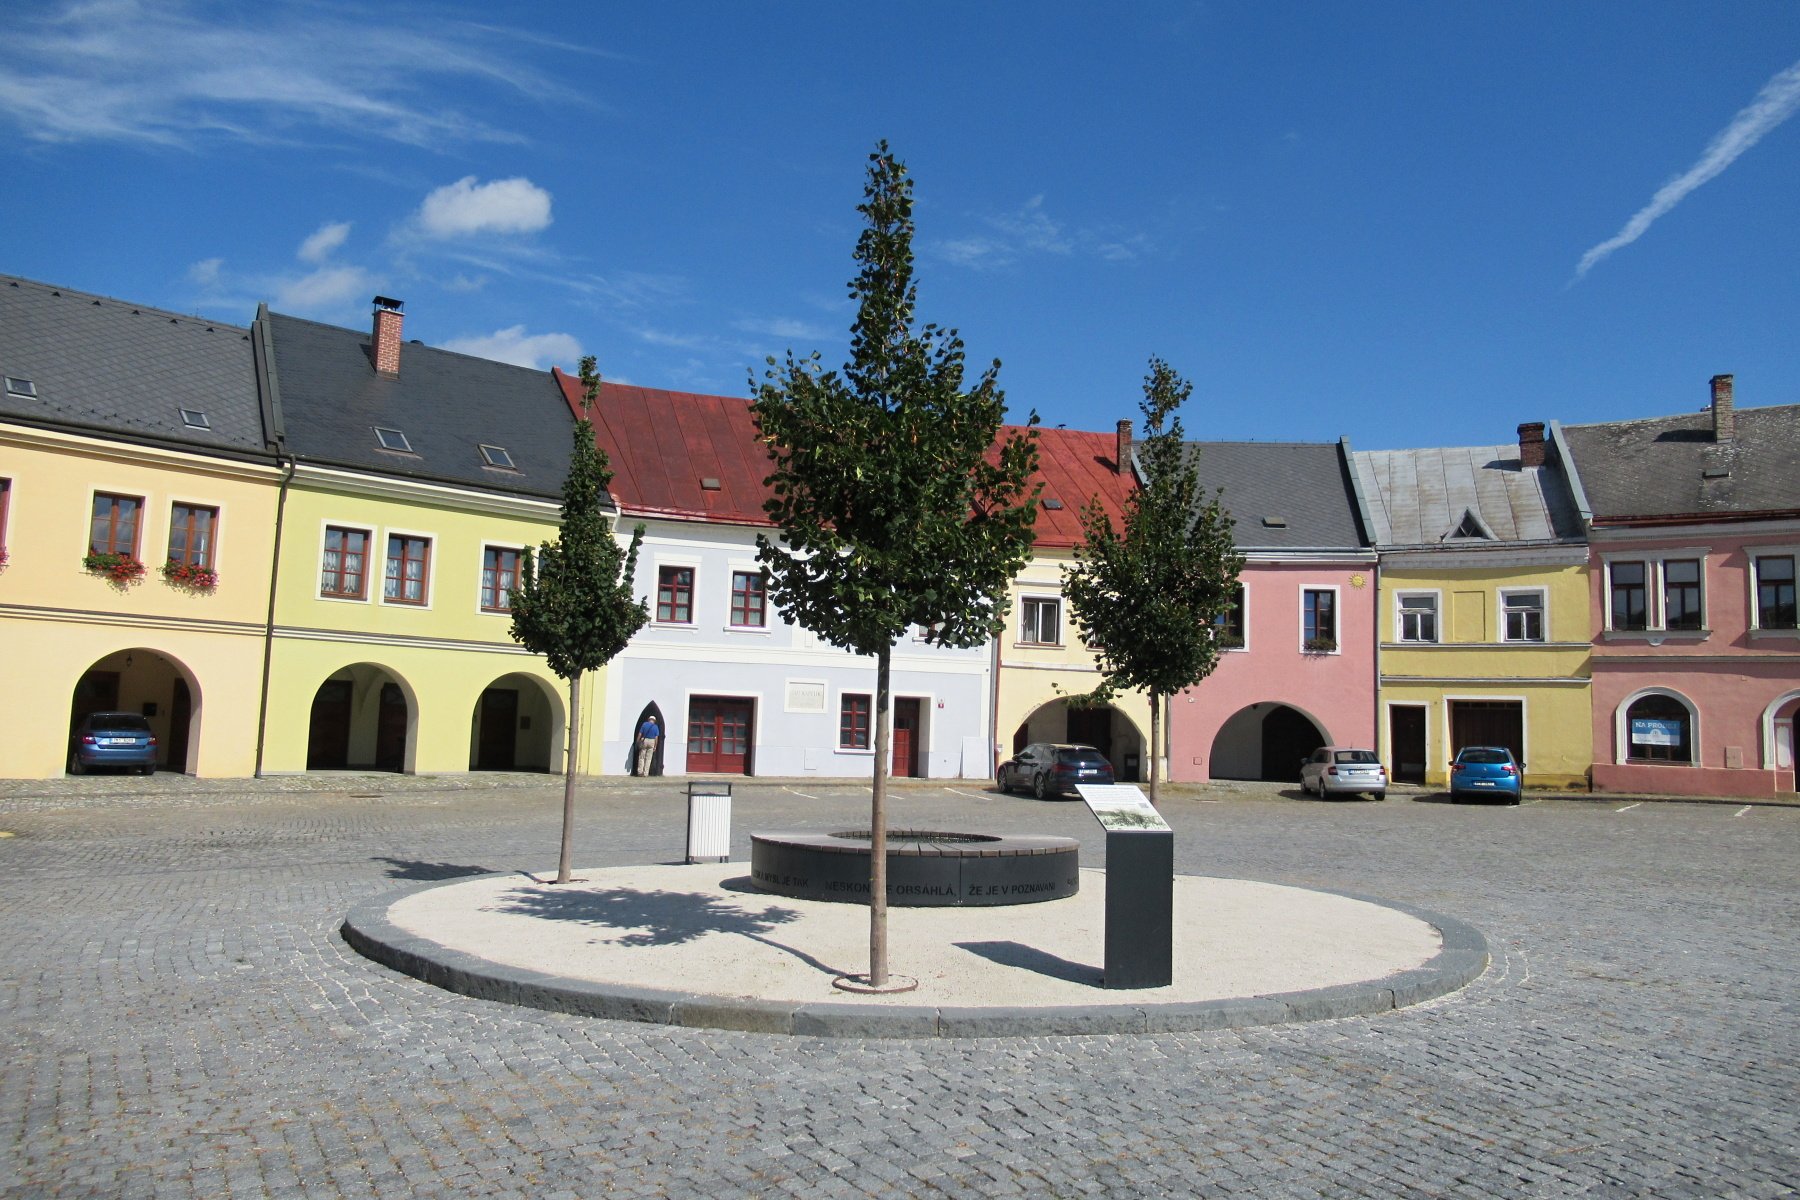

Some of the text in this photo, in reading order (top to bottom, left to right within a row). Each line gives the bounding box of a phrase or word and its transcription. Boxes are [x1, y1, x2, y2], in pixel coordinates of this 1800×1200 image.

[792, 877, 808, 889] TAK
[985, 885, 999, 896] JE
[1001, 885, 1009, 895] V
